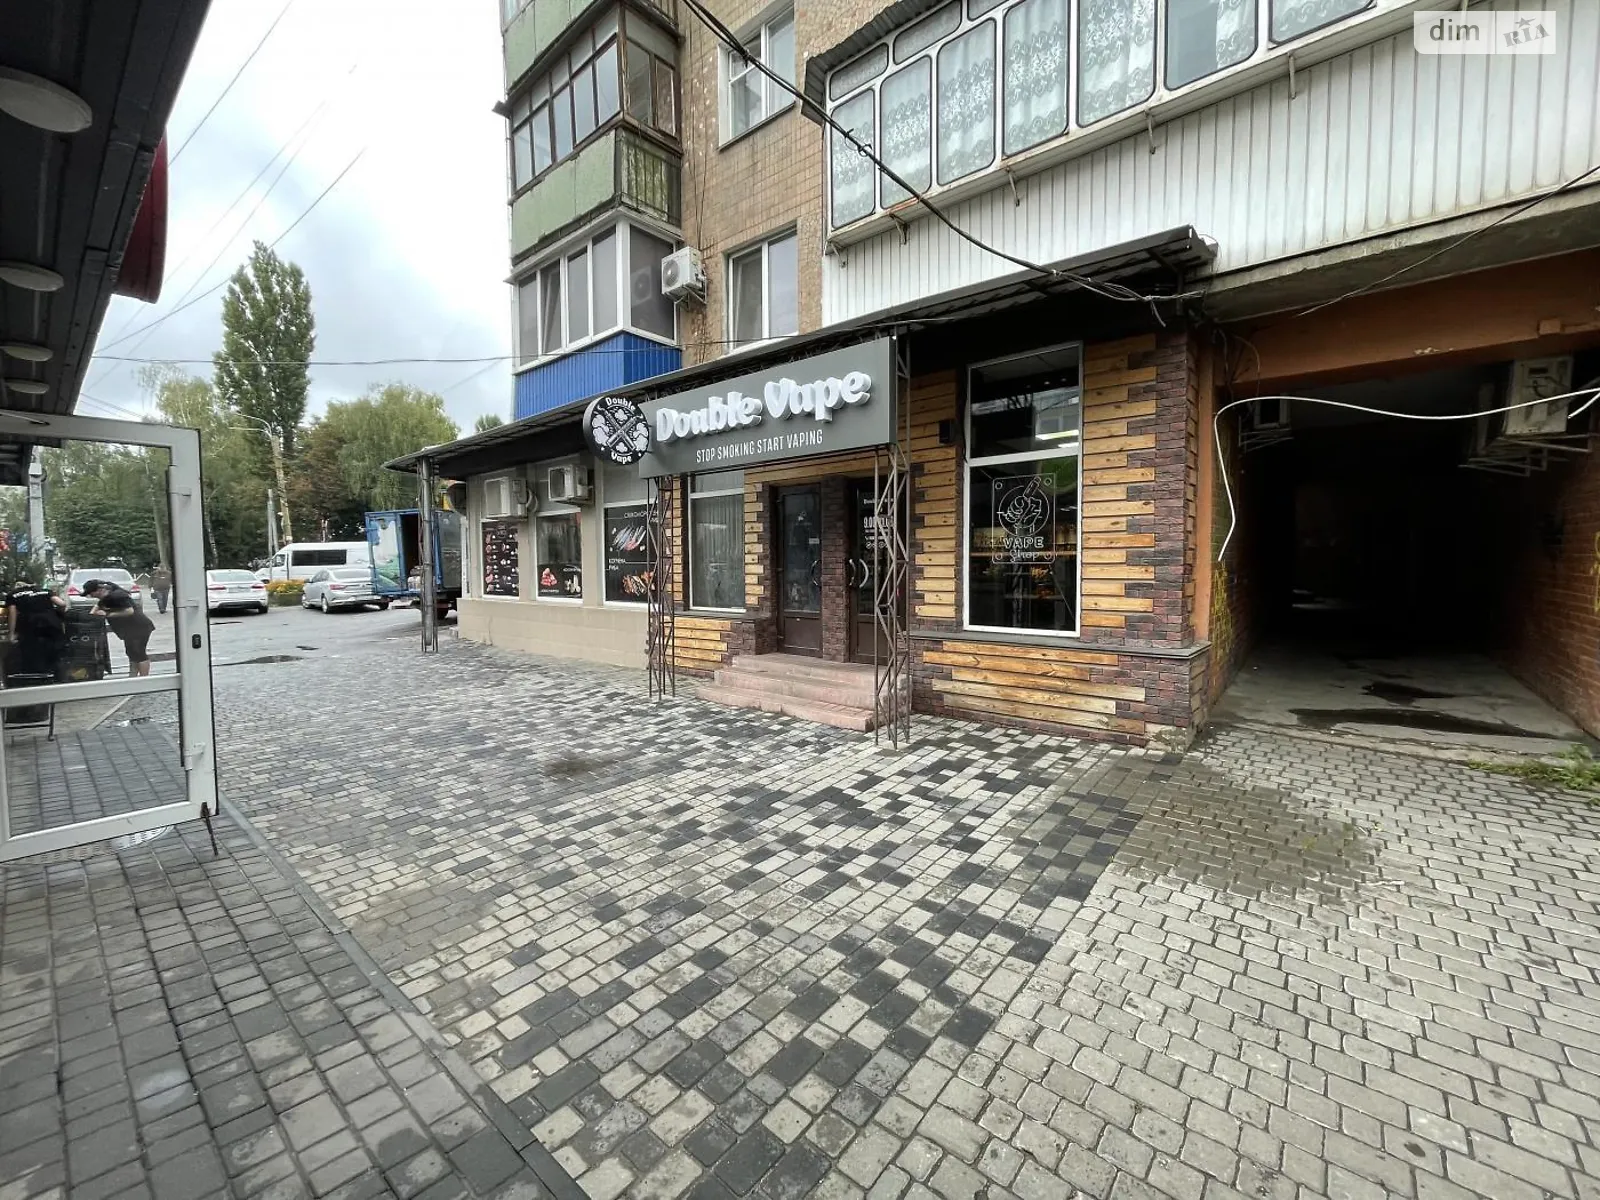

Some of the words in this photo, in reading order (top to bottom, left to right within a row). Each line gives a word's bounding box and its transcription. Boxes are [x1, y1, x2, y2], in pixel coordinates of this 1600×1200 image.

[605, 397, 636, 411] Double
[656, 391, 763, 442] Double
[764, 371, 872, 422] Vape
[696, 447, 715, 463] STOP
[717, 440, 755, 460] SMOKING
[757, 435, 784, 453] START
[786, 429, 823, 449] VAPING
[611, 450, 632, 464] Vape
[1003, 536, 1044, 549] VAPE
